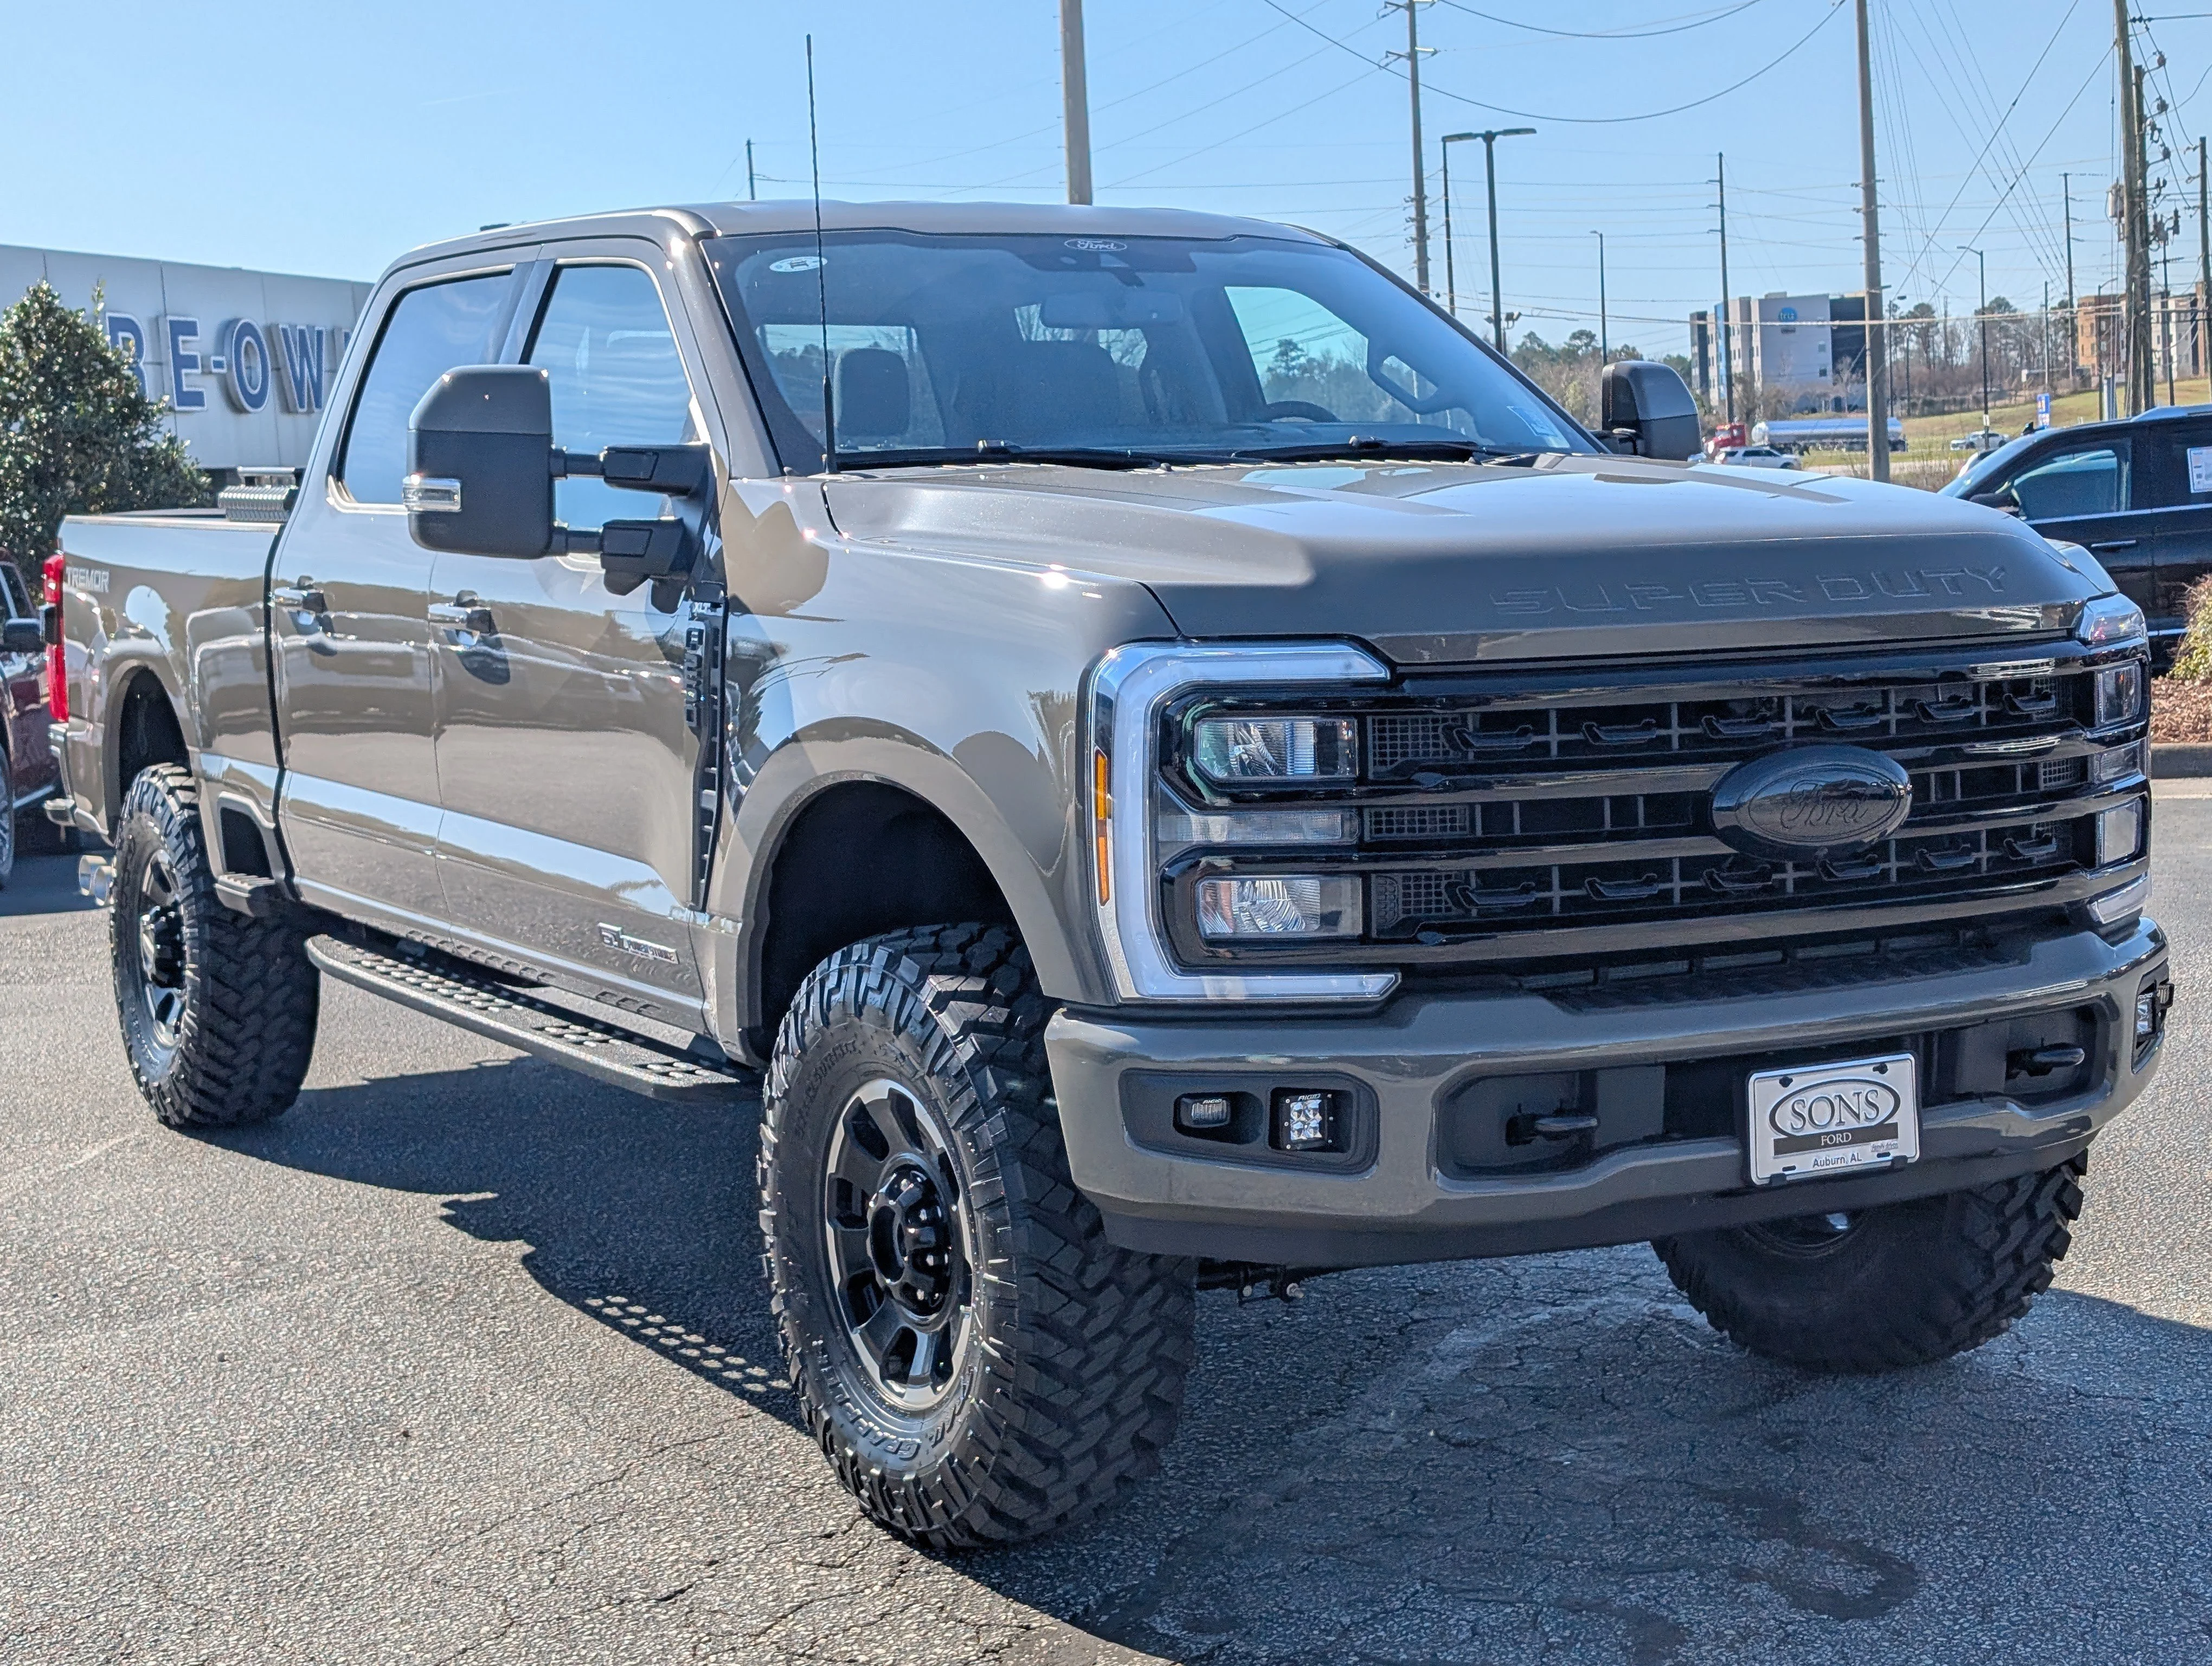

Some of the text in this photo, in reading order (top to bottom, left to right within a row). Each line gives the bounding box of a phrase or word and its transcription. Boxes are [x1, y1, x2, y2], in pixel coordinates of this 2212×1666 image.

[1077, 240, 1117, 249] Ford
[66, 566, 110, 593] TREMOR
[1489, 566, 2005, 615] SUPER DUTY
[1780, 778, 1868, 829] Ford
[1298, 1093, 1321, 1101] RIGID
[1790, 1089, 1880, 1130] SONS
[1820, 1132, 1852, 1146] FORD
[1812, 1152, 1862, 1168] Auburn, AL
